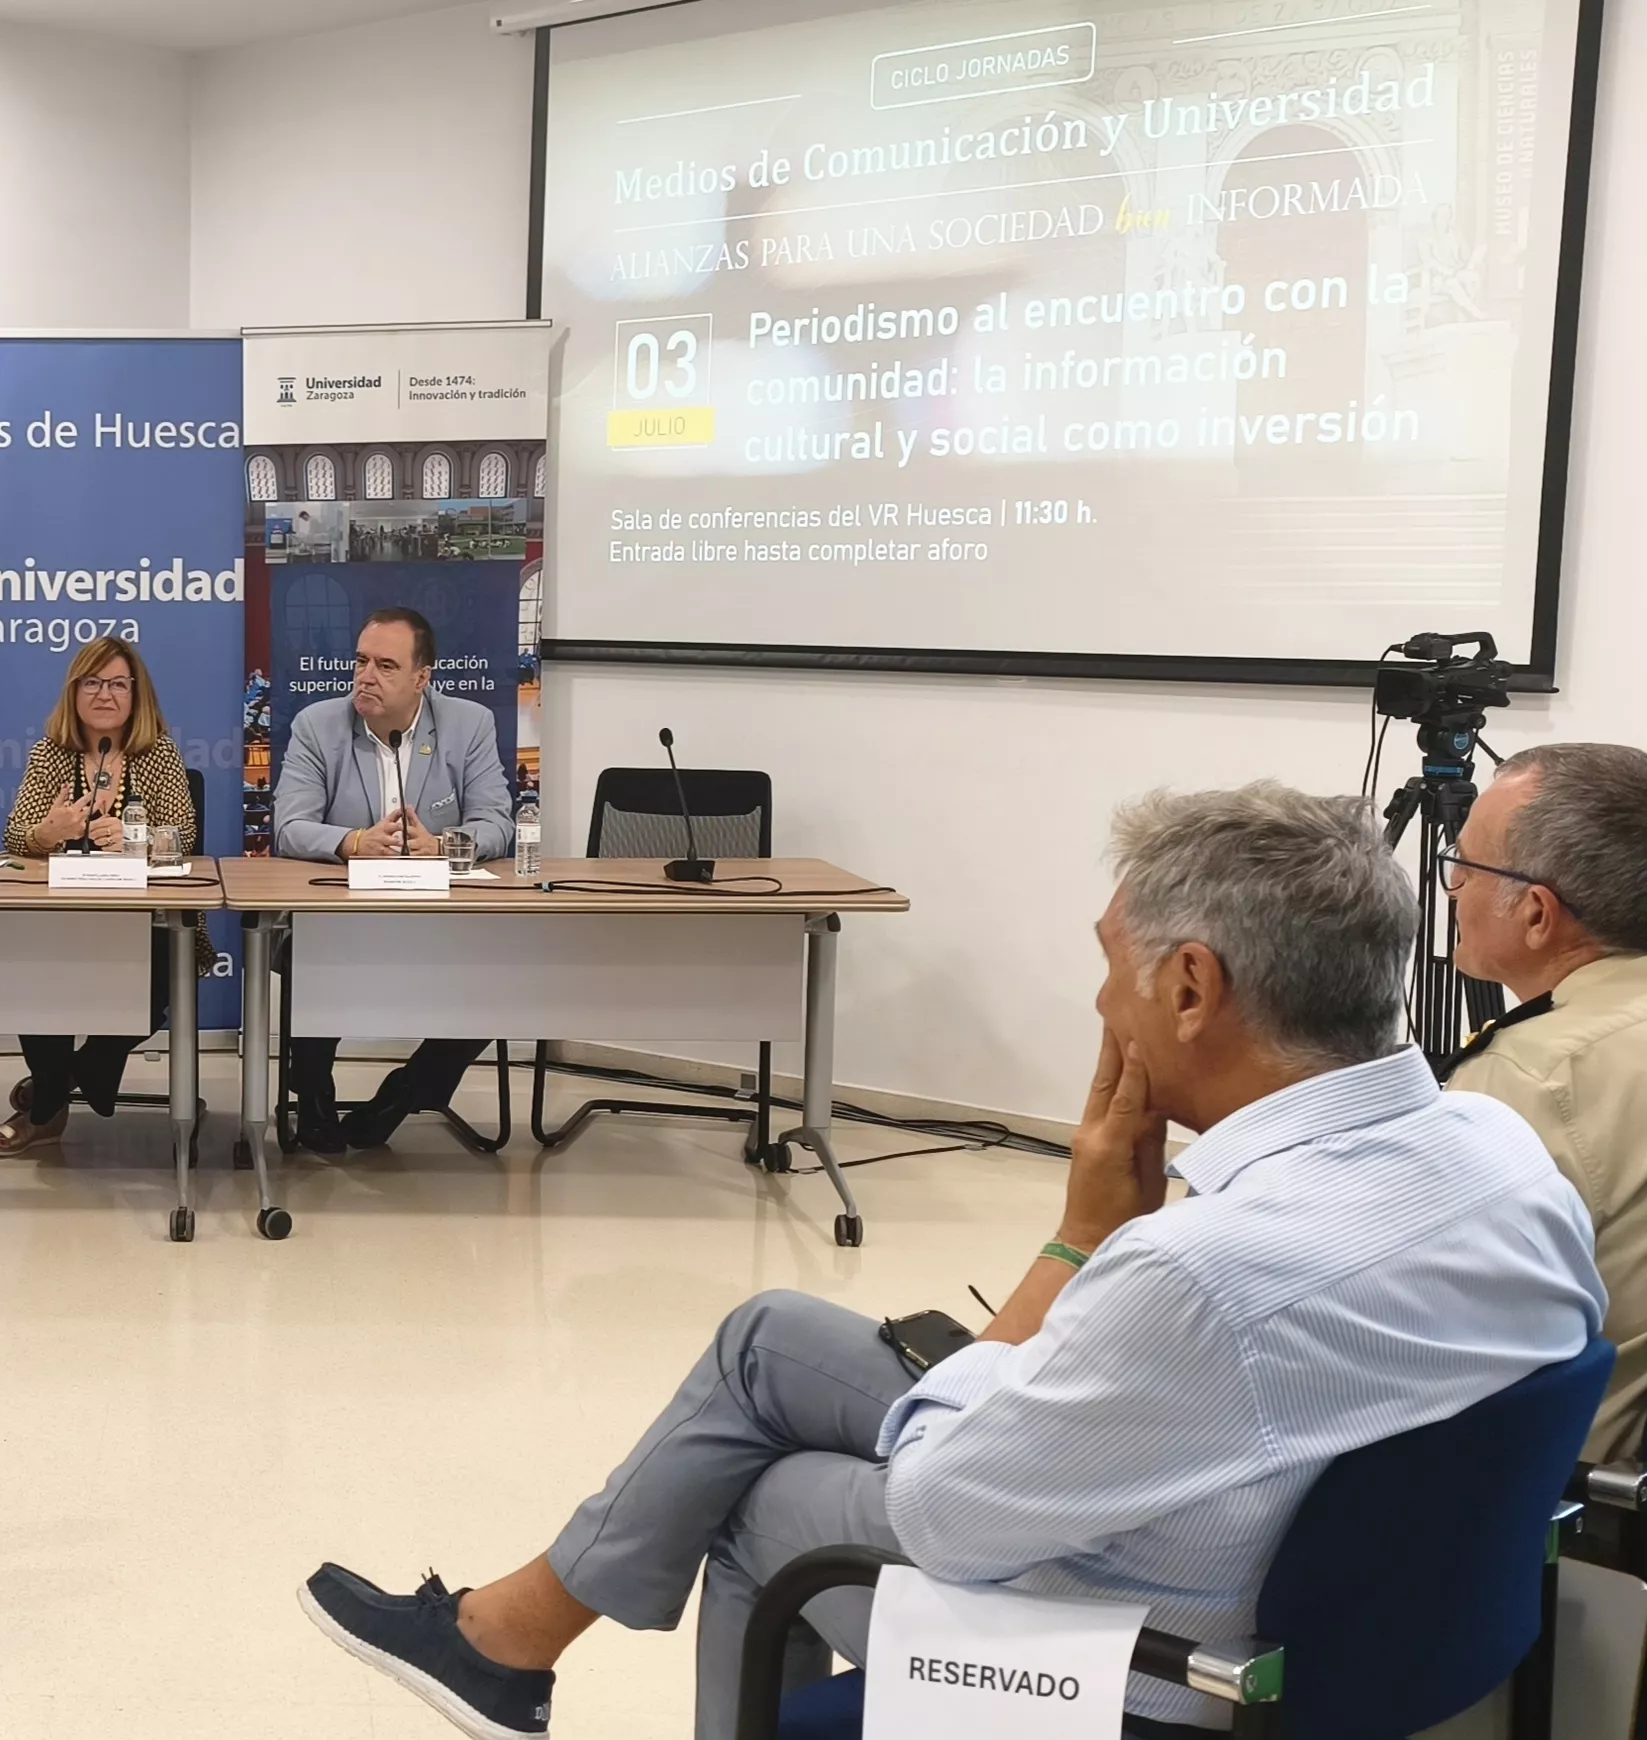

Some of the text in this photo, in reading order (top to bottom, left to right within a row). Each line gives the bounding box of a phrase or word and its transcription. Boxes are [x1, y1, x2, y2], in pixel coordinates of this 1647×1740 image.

[891, 44, 1071, 90] CICLO JORNADAS
[1517, 49, 1539, 163] NATURALES
[614, 61, 1436, 205] Medios de Comunicación y Universidad
[1494, 51, 1516, 236] MUSEO DE CIENCIAS
[609, 238, 749, 282] ALIANZAS
[760, 230, 834, 267] PARA
[847, 223, 917, 258] UNA
[928, 203, 1105, 252] SOCIEDAD
[1185, 168, 1430, 227] INFORMADA
[750, 263, 1410, 349] Periodismo al encuentro con la
[306, 375, 382, 389] Universidad
[409, 376, 476, 387] Desde 1474:
[625, 329, 698, 401] 03
[746, 332, 1287, 406] comunidad: la información
[306, 390, 355, 402] Zaragoza
[409, 388, 527, 401] Innovación y tradición
[26, 410, 79, 449] de
[94, 412, 241, 449] Huesca
[632, 415, 687, 438] JULIO
[744, 393, 1420, 468] cultural y social como inversión
[610, 508, 653, 531] Sala
[658, 508, 683, 530] de
[688, 505, 821, 530] conferencias
[828, 504, 862, 528] del
[868, 503, 899, 527] VR
[907, 502, 993, 527] Huesca
[1014, 500, 1068, 525] 11:30
[1076, 499, 1098, 525] h.
[609, 537, 989, 566] Entrada libre hasta completar aforo
[300, 656, 314, 671] El
[318, 656, 357, 671] futur
[289, 677, 354, 695] superior
[458, 679, 478, 691] en
[481, 676, 495, 691] la
[908, 1656, 1080, 1701] RESERVADO
